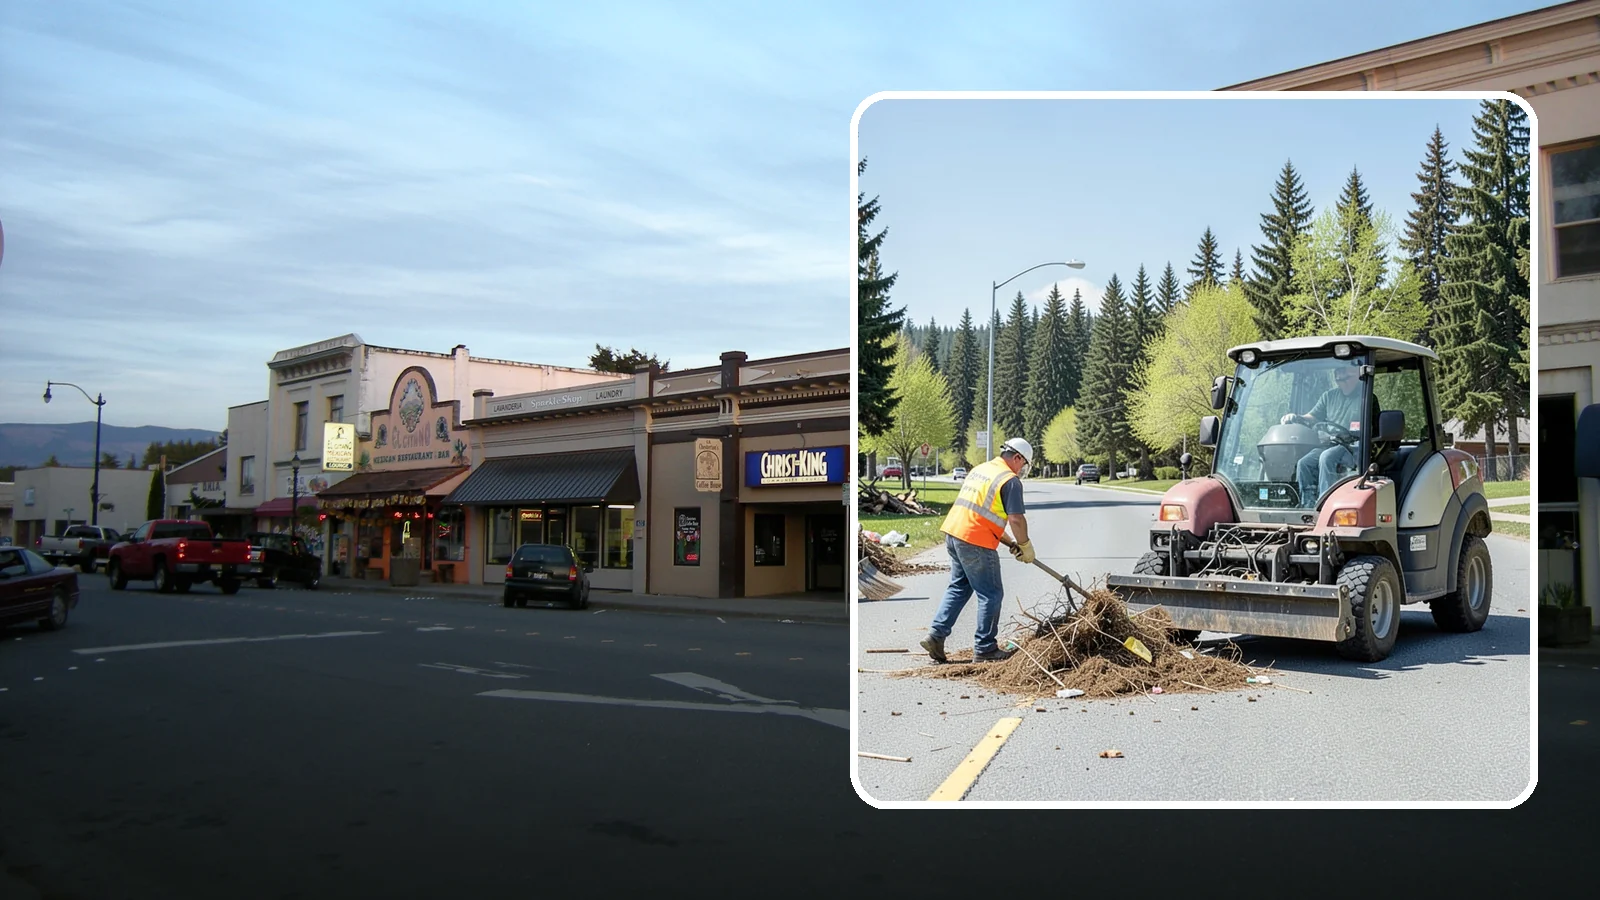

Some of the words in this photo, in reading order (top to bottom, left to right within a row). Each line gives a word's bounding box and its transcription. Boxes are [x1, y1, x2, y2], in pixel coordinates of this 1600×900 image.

[595, 389, 623, 400] LAUNDRY
[493, 402, 523, 413] LAVANDERIA
[530, 397, 560, 409] Sparkle
[561, 395, 582, 406] Shop
[374, 455, 395, 464] MEXICAN
[398, 451, 434, 462] RESTAURANT
[438, 450, 450, 459] BAR
[761, 452, 797, 478] CHRIST
[799, 449, 827, 476] KING
